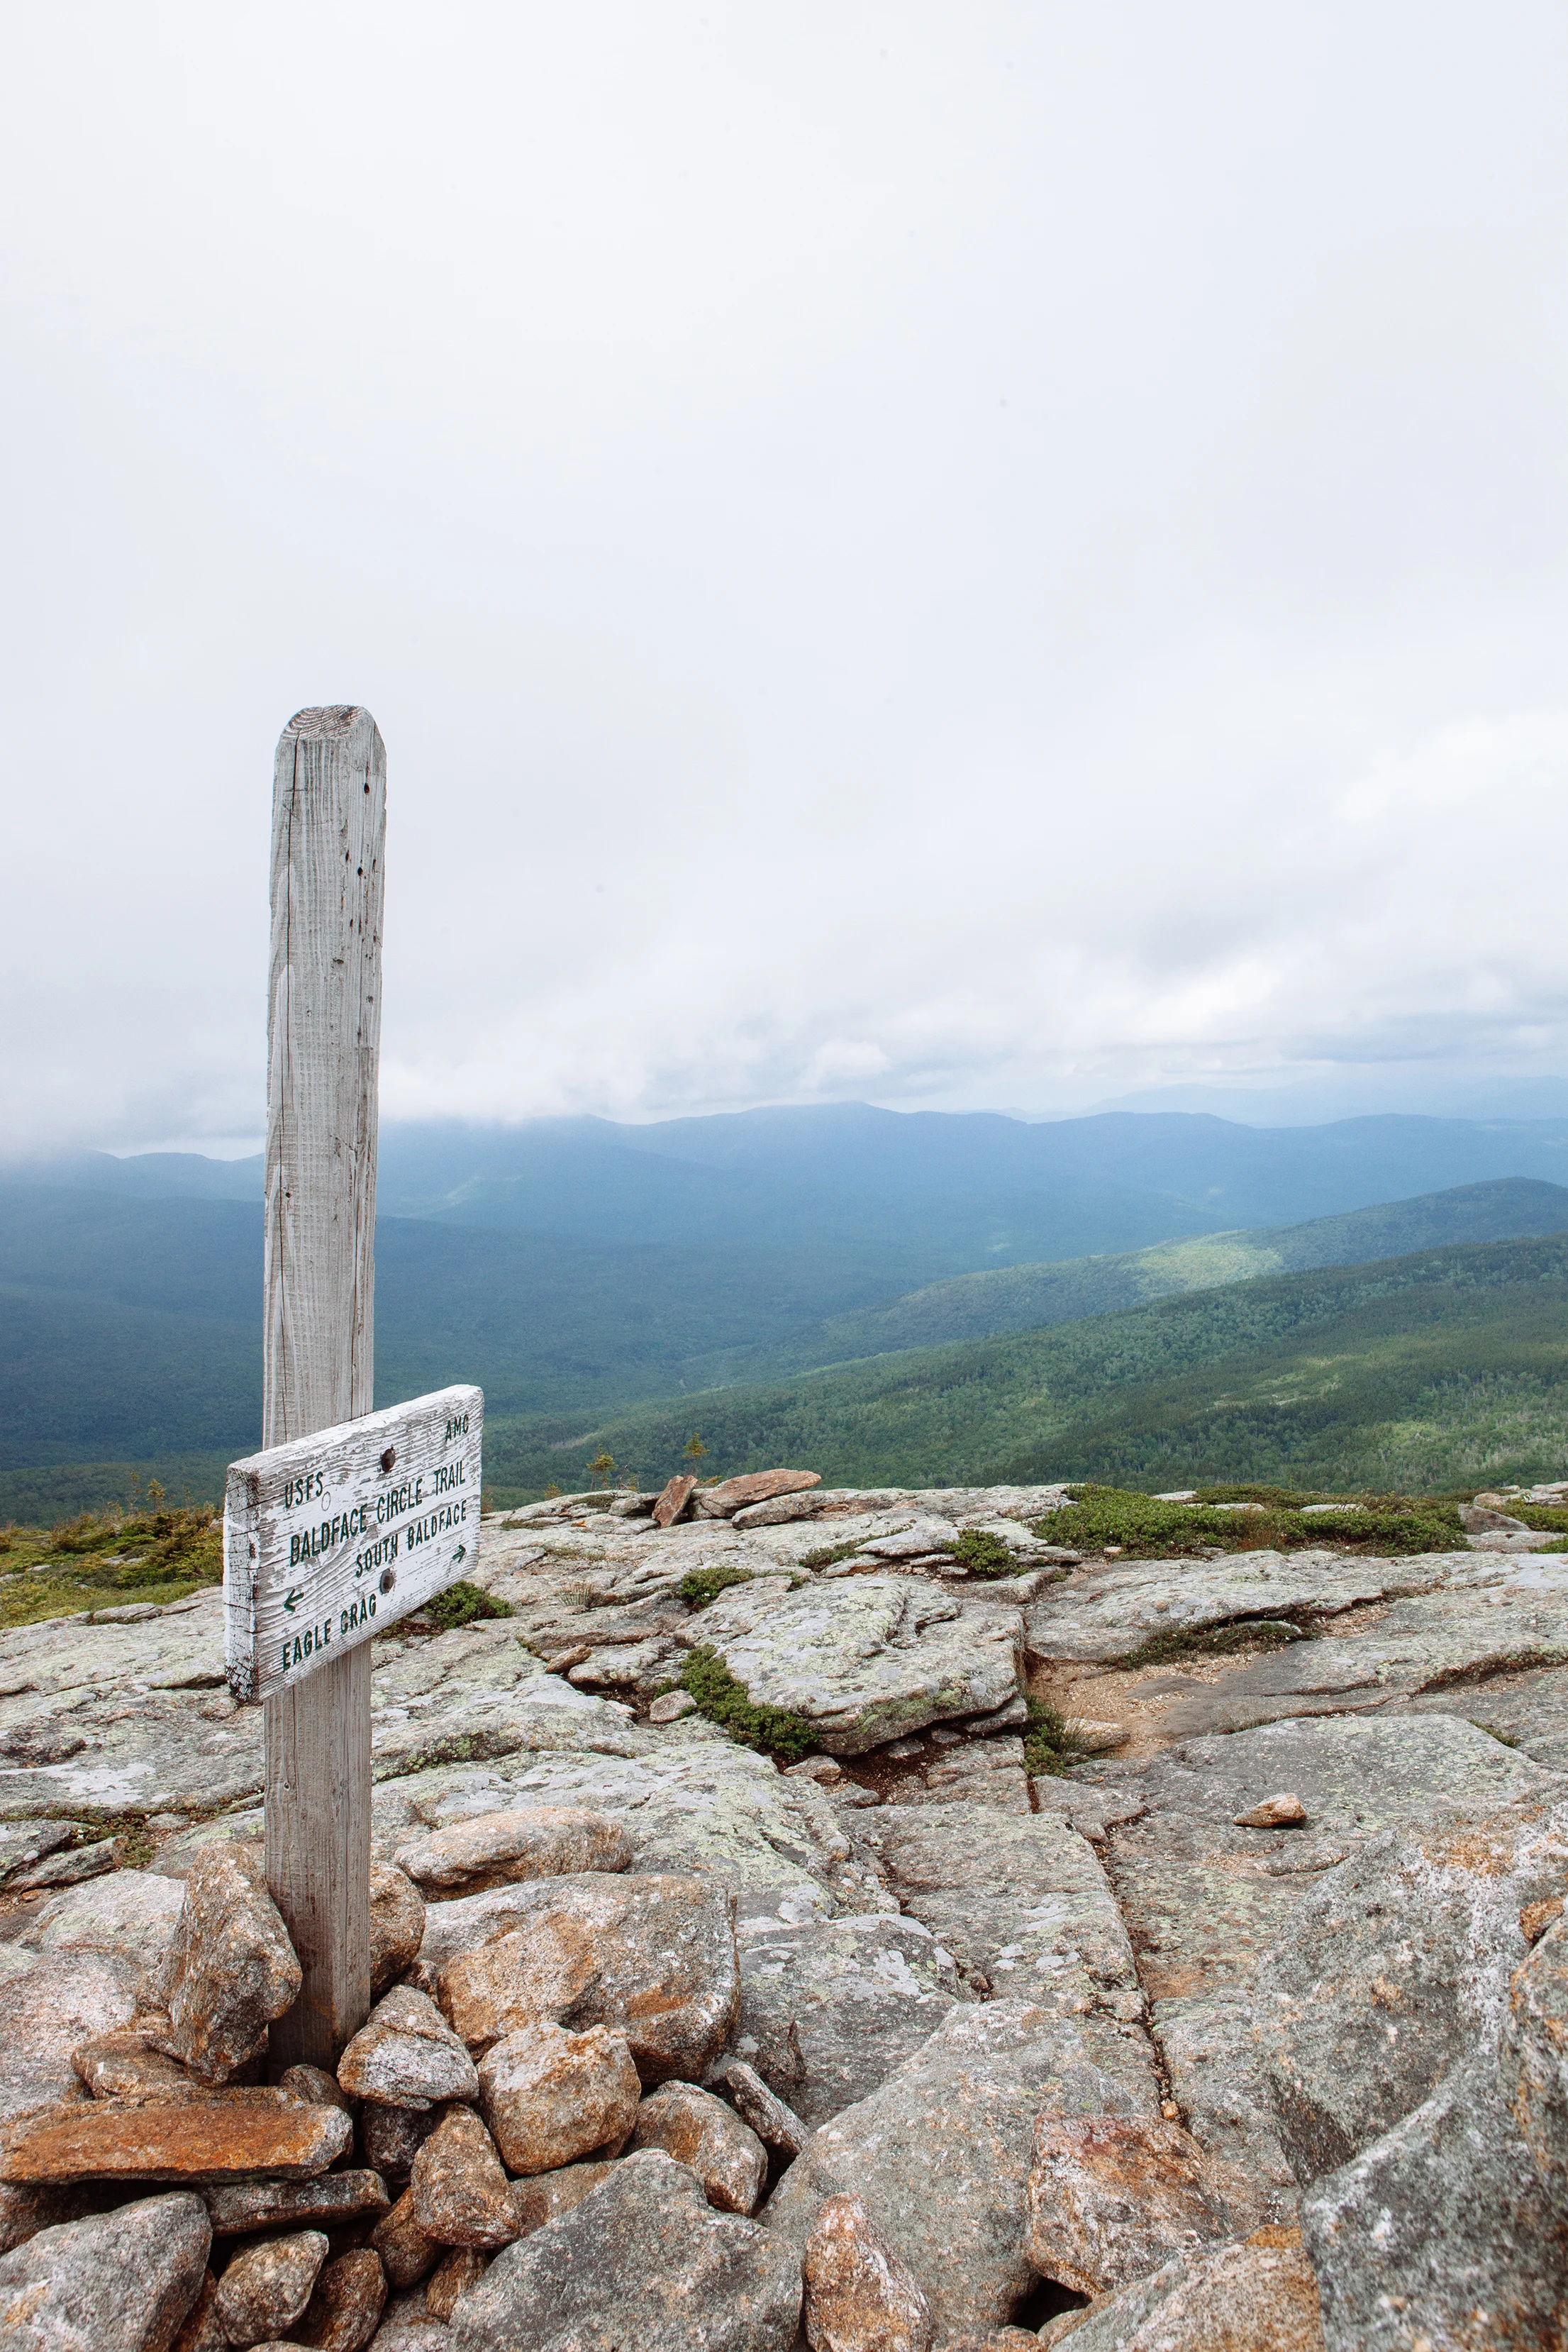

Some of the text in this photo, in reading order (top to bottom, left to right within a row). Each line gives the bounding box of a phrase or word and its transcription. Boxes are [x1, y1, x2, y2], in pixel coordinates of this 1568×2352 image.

[445, 1414, 469, 1442] AMC
[284, 1471, 324, 1509] USFS
[289, 1460, 466, 1568] BALDFACE CIRCLE TRAIL
[355, 1499, 467, 1578] SOUTH BALDFACE
[282, 1594, 377, 1670] EAGLE CRAG
